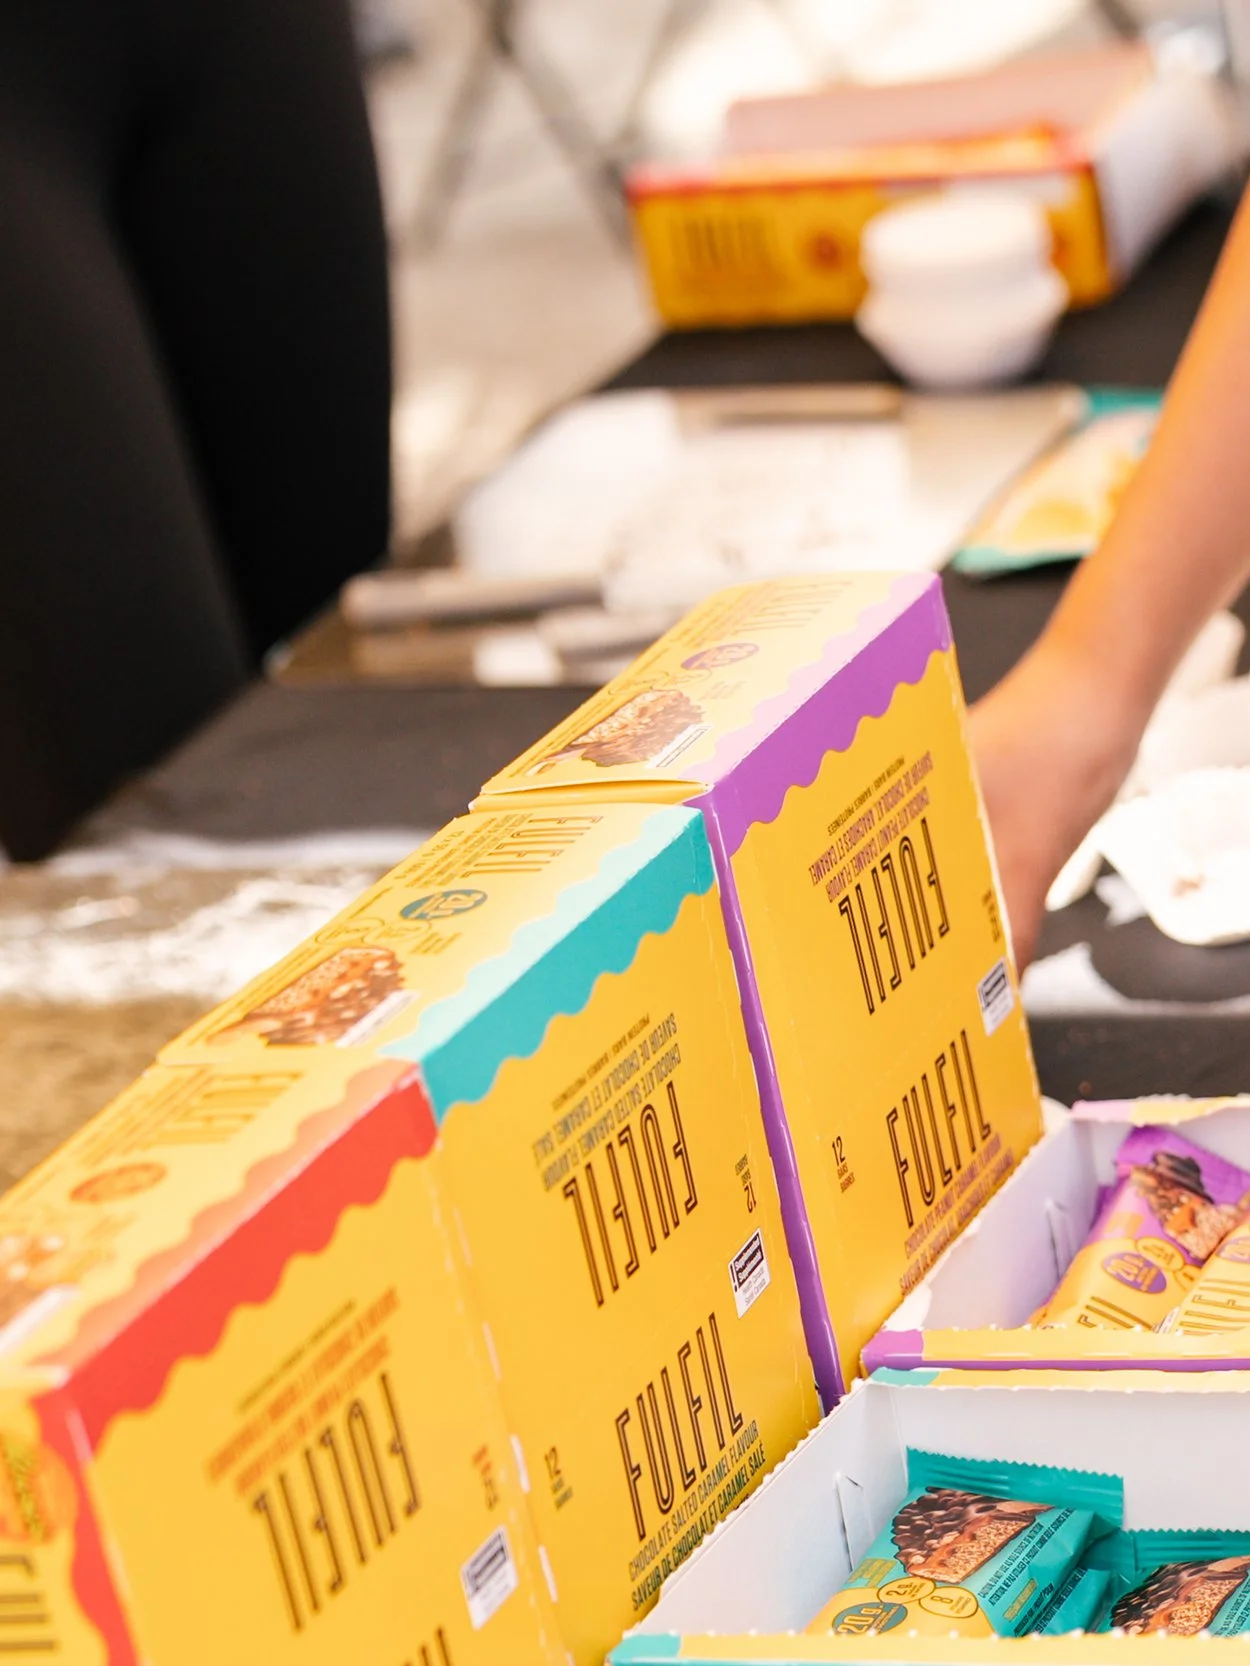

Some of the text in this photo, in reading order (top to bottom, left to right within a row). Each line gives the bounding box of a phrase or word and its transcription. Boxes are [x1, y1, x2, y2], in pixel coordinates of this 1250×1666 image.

[460, 814, 604, 878] FULFIL
[838, 816, 950, 1015] FULFIL
[613, 1080, 643, 1124] SALTED
[639, 1041, 682, 1097] CHOCOLATE
[647, 1011, 678, 1056] SAVEUR
[562, 1080, 698, 1309] FULFIL
[742, 1180, 758, 1214] 12
[830, 1134, 846, 1167] 12
[885, 1028, 991, 1229] FULFIL
[253, 1369, 422, 1635] FULFIL
[614, 1311, 743, 1542] FULFIL
[627, 1418, 761, 1585] CHOCOLATE SALTED CARAMEL FLAVOUR
[630, 1562, 662, 1614] SAVEUR
[660, 1550, 673, 1580] DE
[671, 1509, 710, 1568] CHOCOLAT
[706, 1498, 719, 1526] ET
[716, 1462, 750, 1514] CARAMEL
